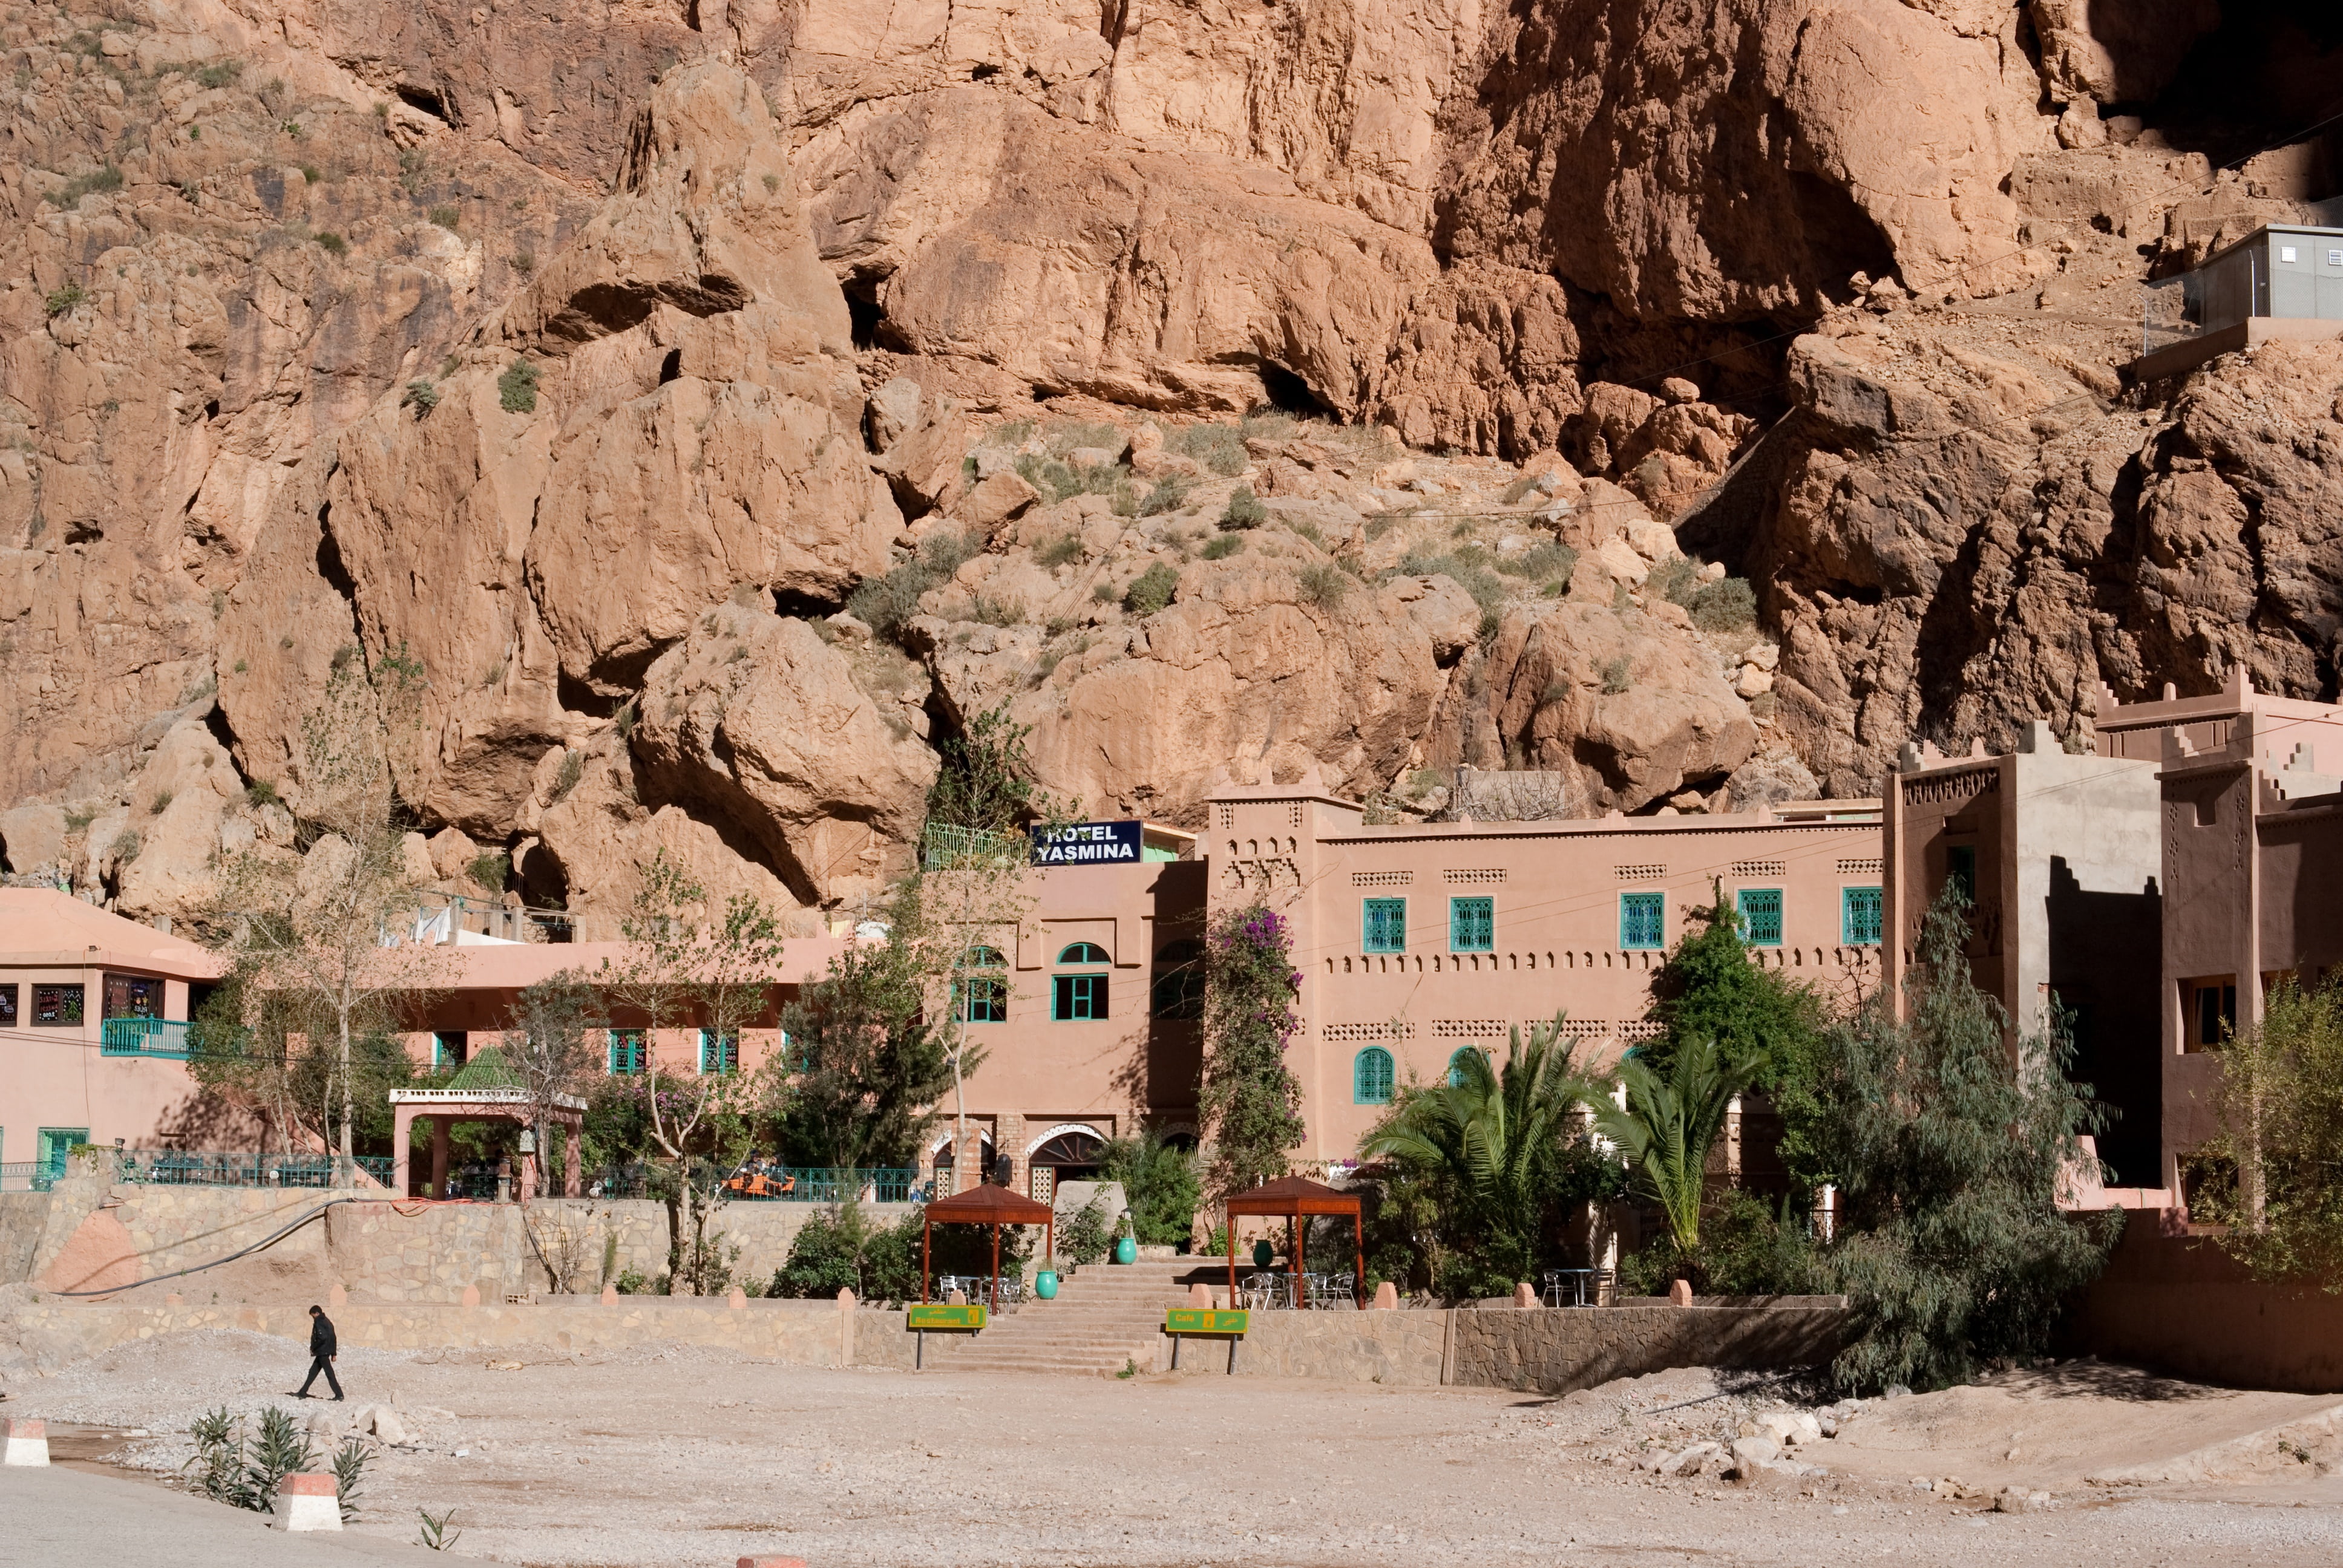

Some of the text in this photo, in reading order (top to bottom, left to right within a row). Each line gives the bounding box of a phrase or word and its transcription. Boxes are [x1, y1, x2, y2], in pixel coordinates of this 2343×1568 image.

[1047, 826, 1118, 843] HOTEL
[1038, 843, 1133, 861] YASMINA
[1176, 1314, 1194, 1322] Café
